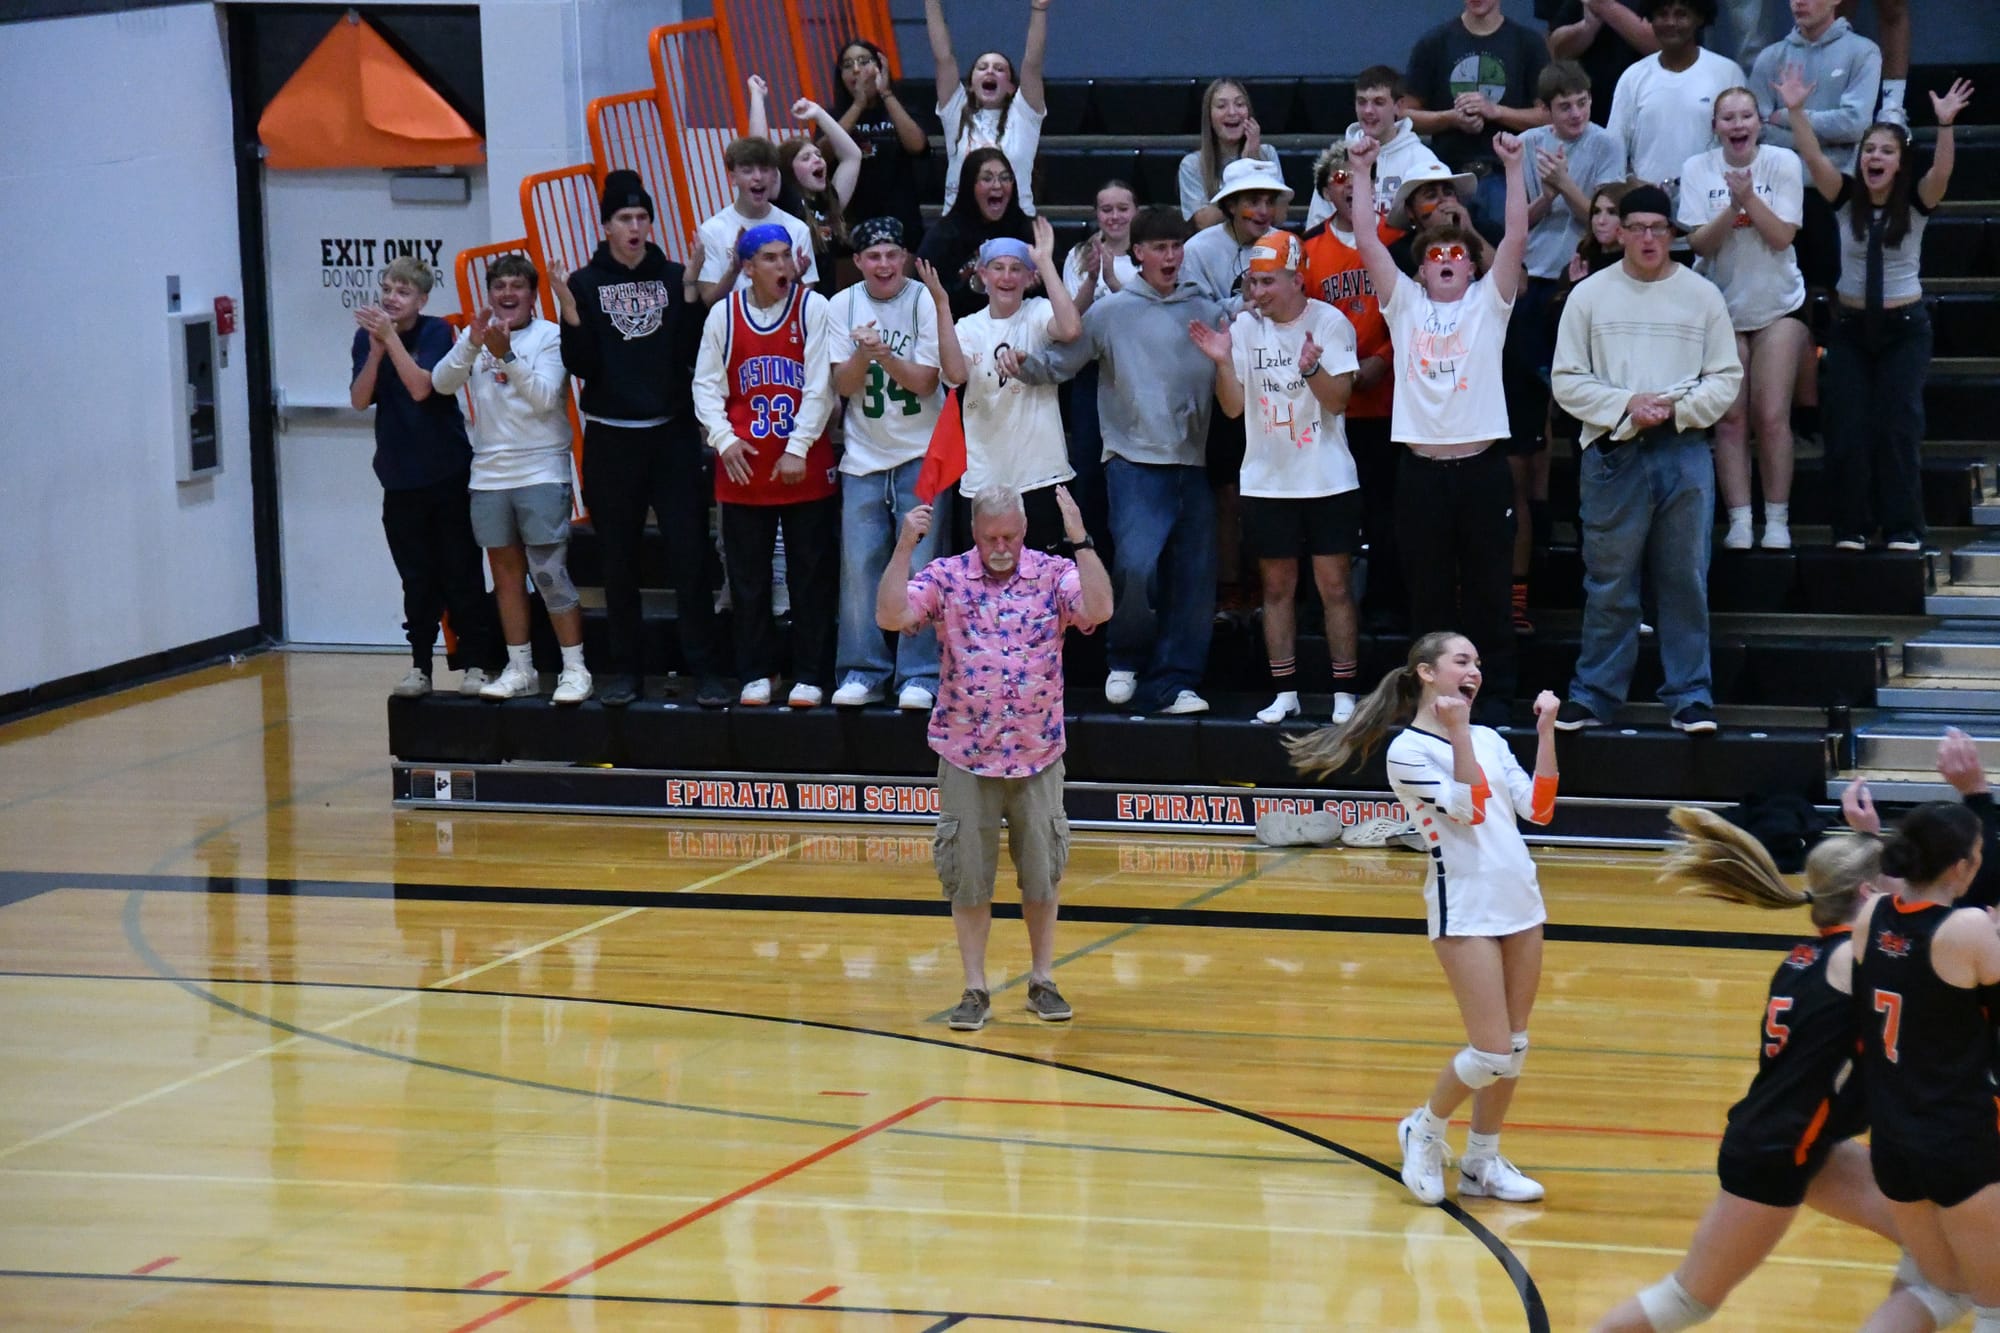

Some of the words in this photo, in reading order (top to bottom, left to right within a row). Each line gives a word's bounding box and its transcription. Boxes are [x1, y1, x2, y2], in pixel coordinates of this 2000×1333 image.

[1709, 184, 1772, 199] EPTA
[320, 239, 376, 267] EXIT
[383, 239, 443, 267] ONLY
[322, 269, 342, 288] DO
[345, 269, 373, 288] NOT
[598, 280, 666, 300] EPHRATA
[1320, 269, 1377, 303] BEAVE
[341, 289, 369, 308] GYM
[862, 363, 921, 418] 34
[1261, 379, 1280, 392] the
[1286, 379, 1306, 391] one
[750, 394, 795, 438] 33
[666, 779, 789, 809] EPHRATA
[797, 784, 857, 811] HIGH
[864, 786, 940, 813] SCHOO
[1117, 793, 1245, 823] EPHRATA
[1322, 800, 1408, 827] SCHOO
[1765, 997, 1793, 1058] 5
[1874, 989, 1902, 1064] 7
